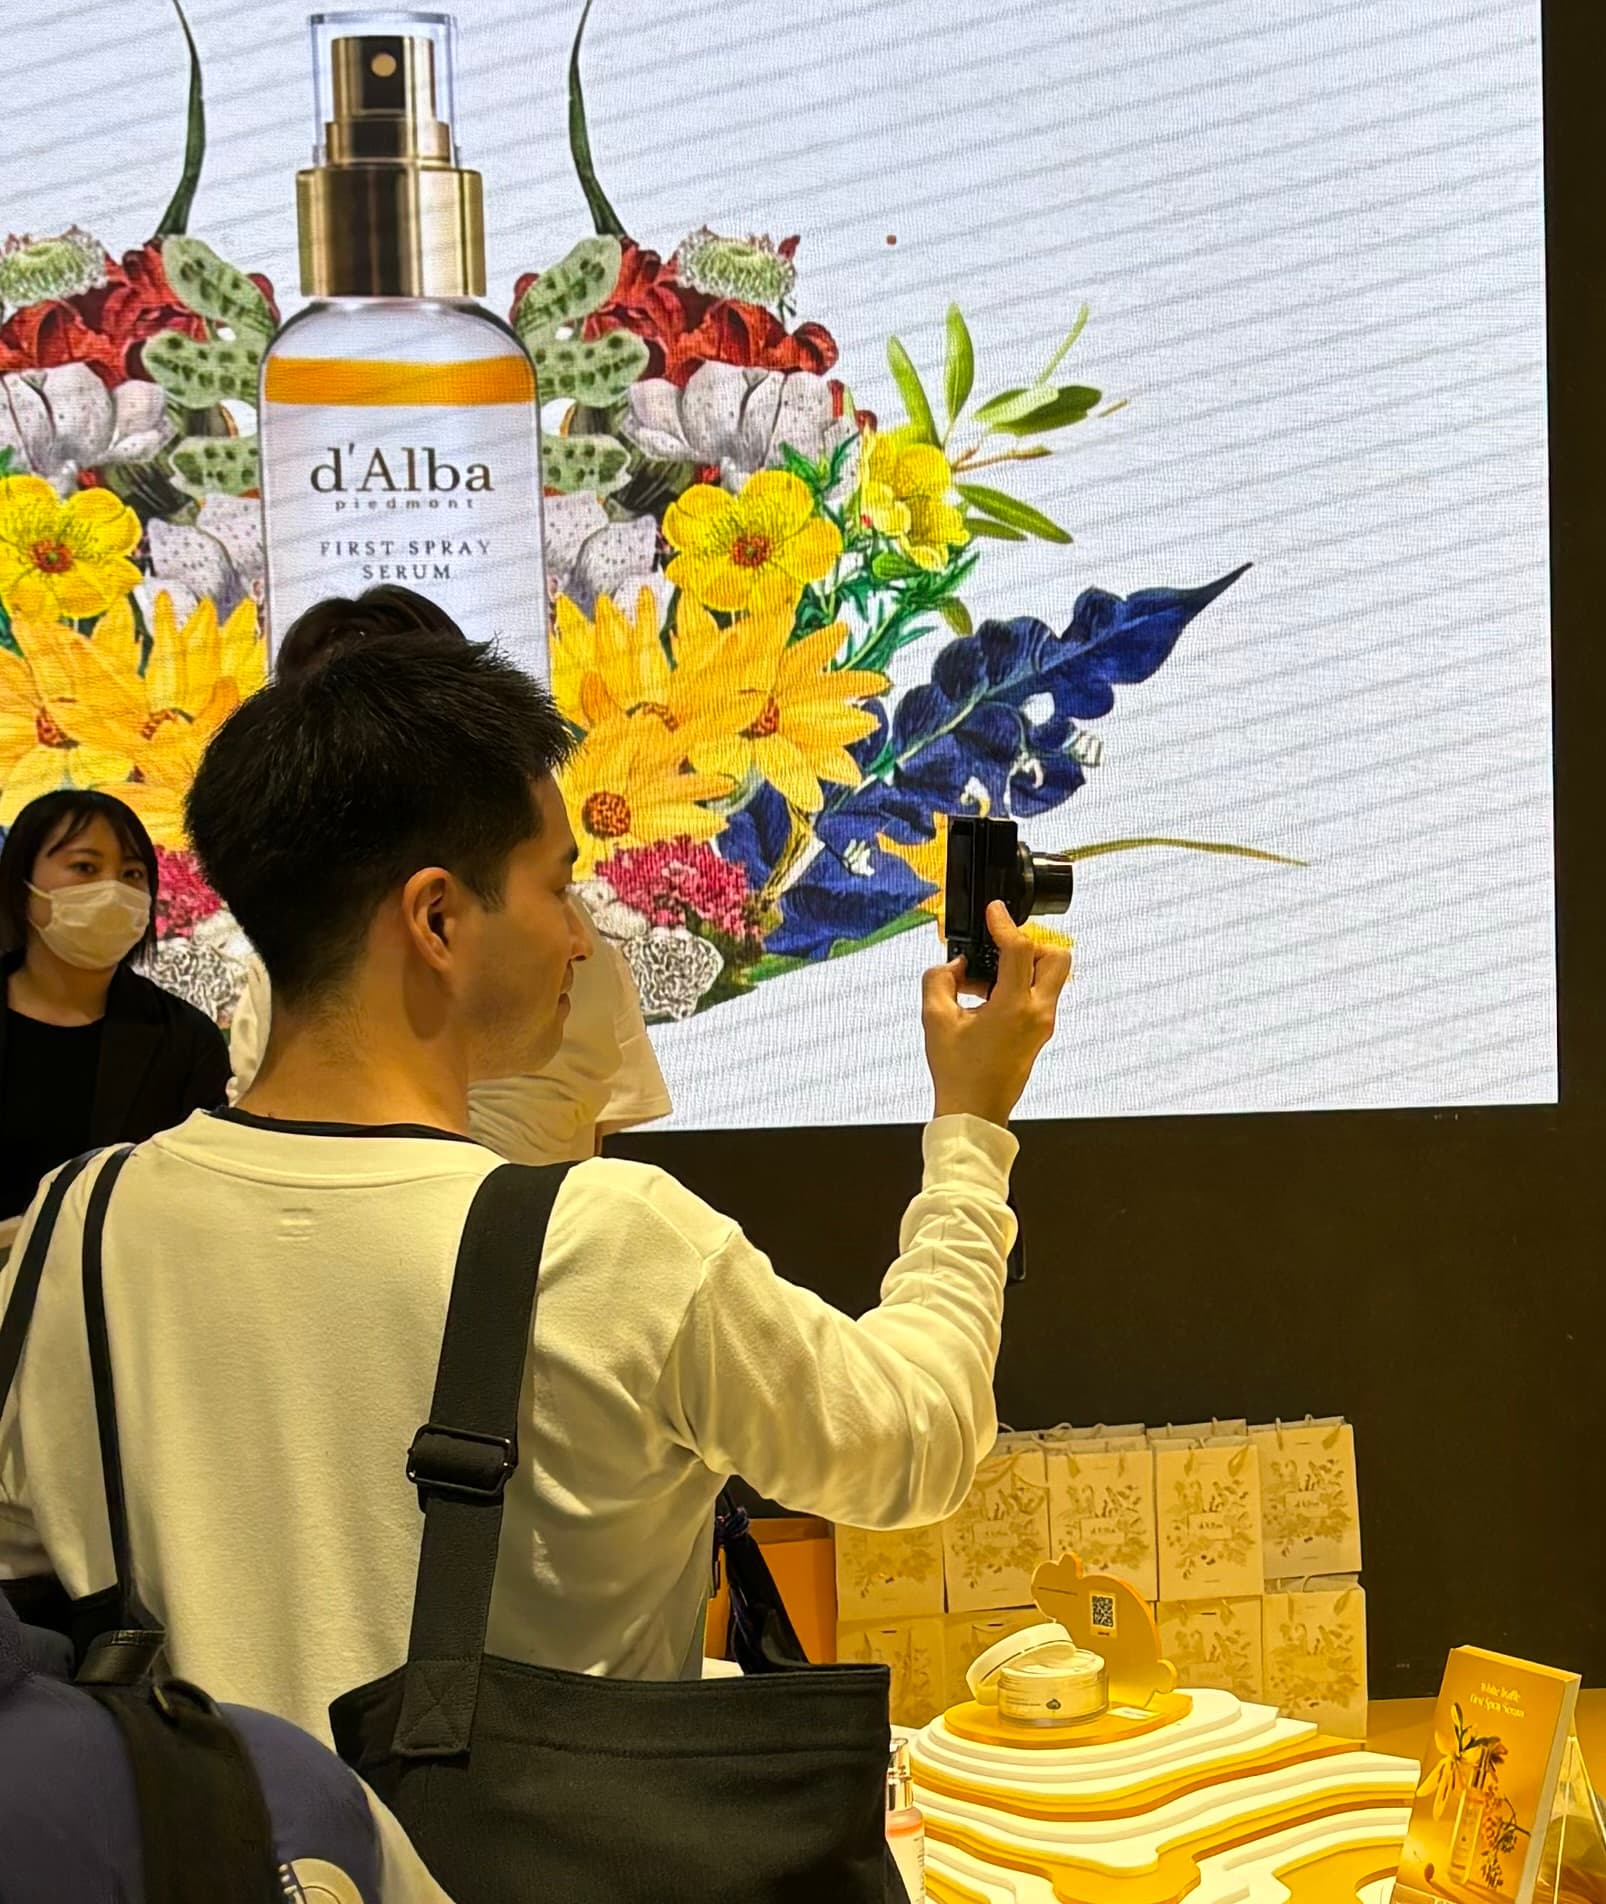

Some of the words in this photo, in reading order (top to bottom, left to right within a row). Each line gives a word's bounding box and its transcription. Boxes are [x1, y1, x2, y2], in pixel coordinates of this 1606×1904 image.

[309, 442, 495, 494] d'Alba
[335, 498, 474, 512] piedmont
[320, 541, 396, 556] FIRST
[408, 540, 491, 556] SPRAY
[361, 563, 452, 581] SERUM
